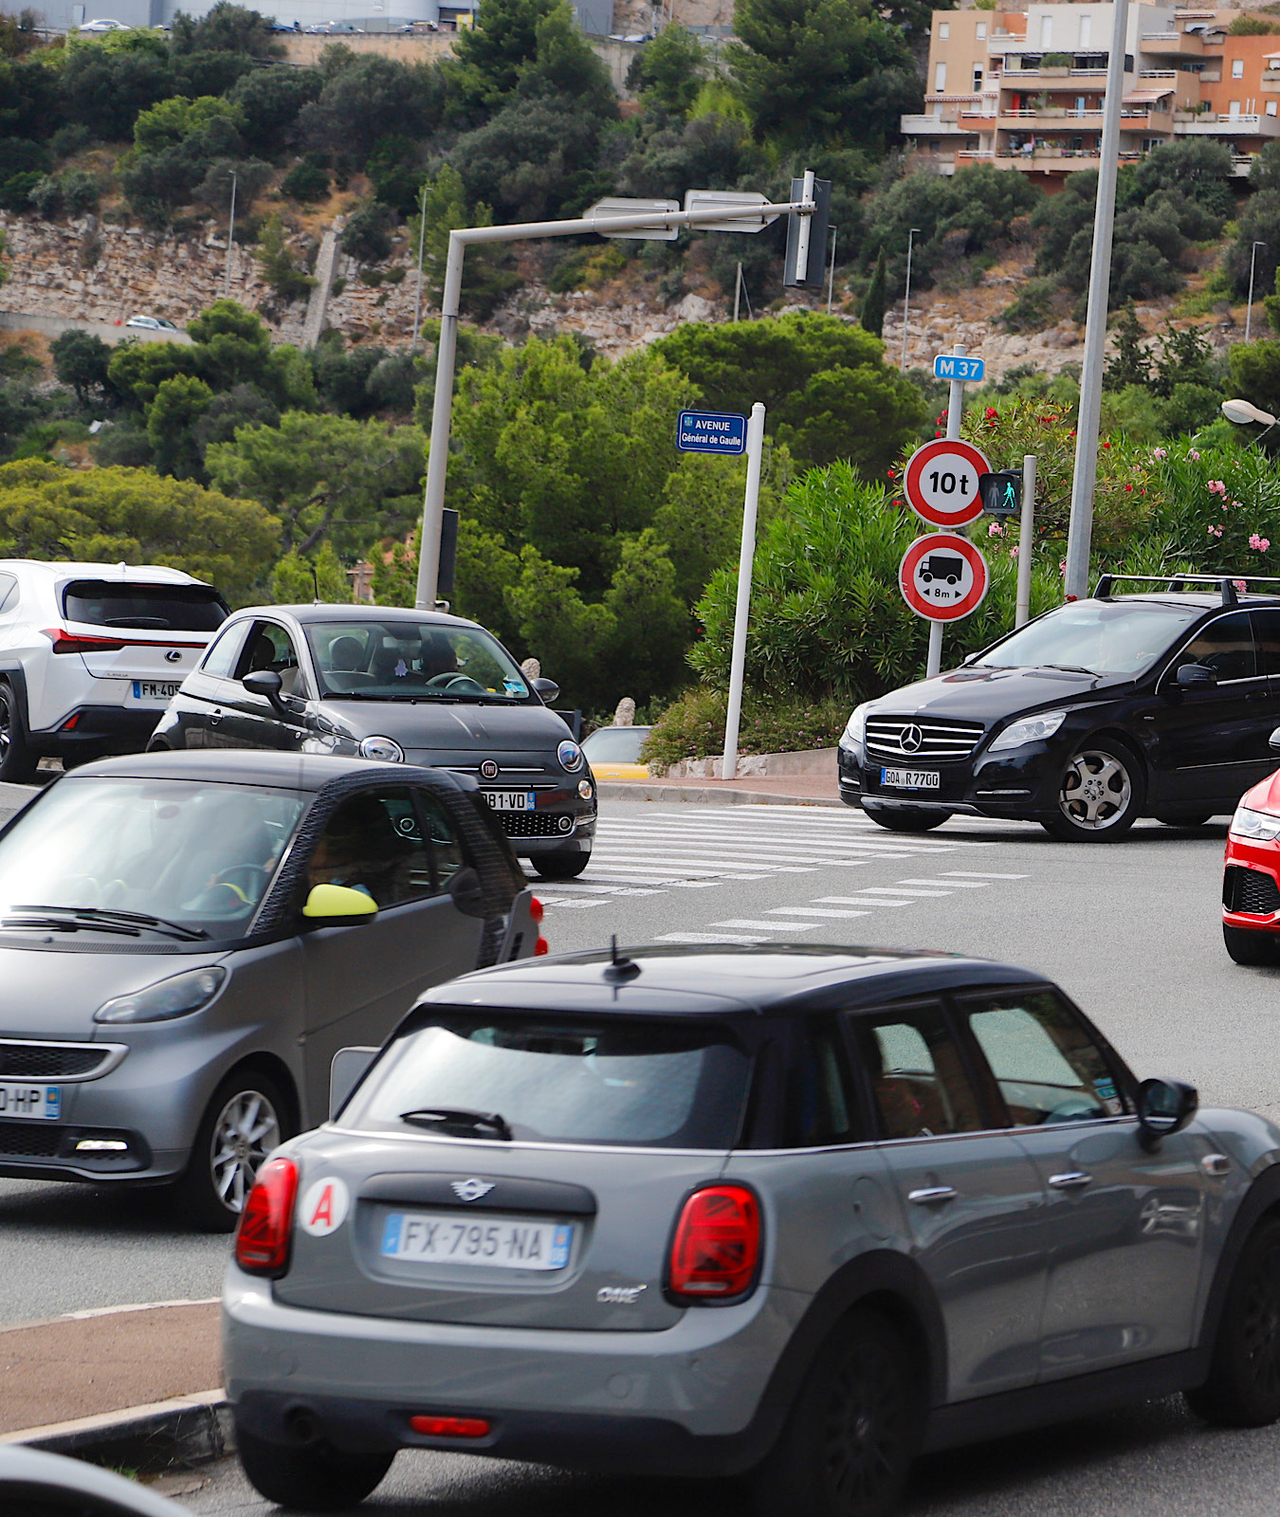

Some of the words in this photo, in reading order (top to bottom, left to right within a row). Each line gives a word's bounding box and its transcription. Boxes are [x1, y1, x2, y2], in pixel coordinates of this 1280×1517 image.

[940, 360, 955, 375] M
[958, 361, 980, 377] 37
[695, 420, 731, 431] AVENUE
[681, 432, 708, 444] Général
[709, 435, 719, 444] de
[719, 435, 741, 446] Gaulle
[885, 771, 900, 783] GOA
[905, 772, 912, 785] R
[913, 773, 938, 786] 7700
[309, 1184, 334, 1227] A
[403, 1221, 542, 1261] FX-795-NA
